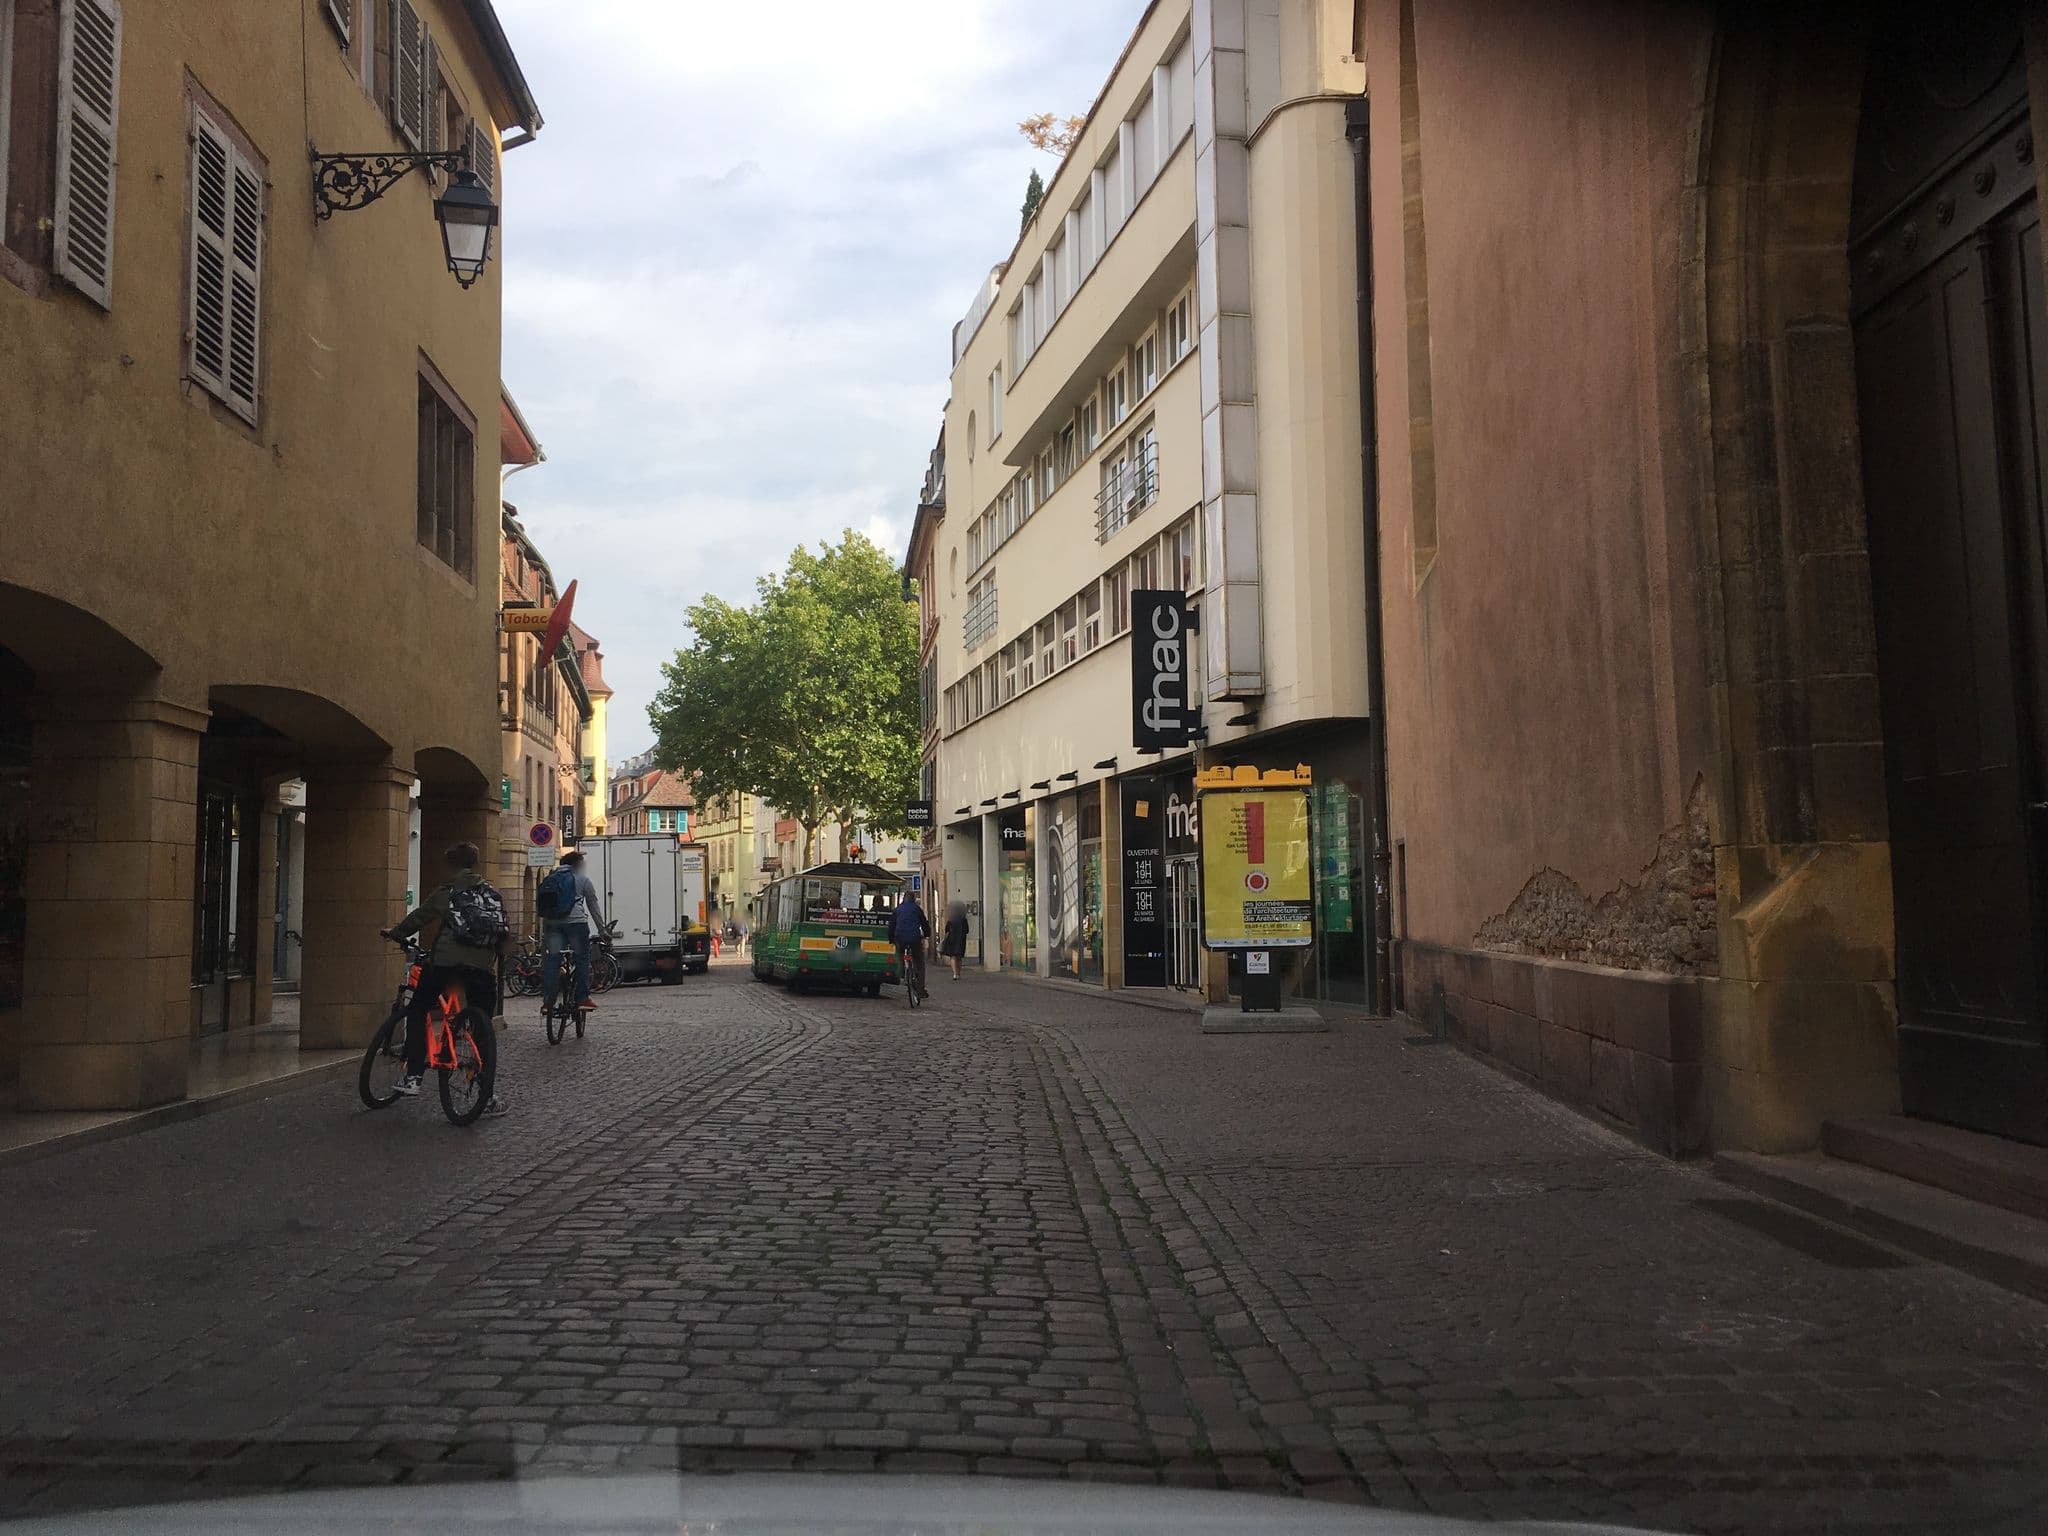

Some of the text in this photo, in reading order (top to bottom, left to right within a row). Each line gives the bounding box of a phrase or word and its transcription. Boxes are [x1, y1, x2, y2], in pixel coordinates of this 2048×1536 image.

[506, 612, 548, 625] Tabac
[1142, 605, 1181, 732] fnac
[1166, 792, 1198, 838] fna
[1003, 827, 1026, 838] fna
[1127, 848, 1160, 857] OUVERTURE
[1135, 860, 1152, 870] 14H
[1135, 870, 1152, 879] 19H
[1135, 891, 1152, 901] 10H
[1136, 901, 1153, 911] 19H
[837, 938, 847, 947] 40
